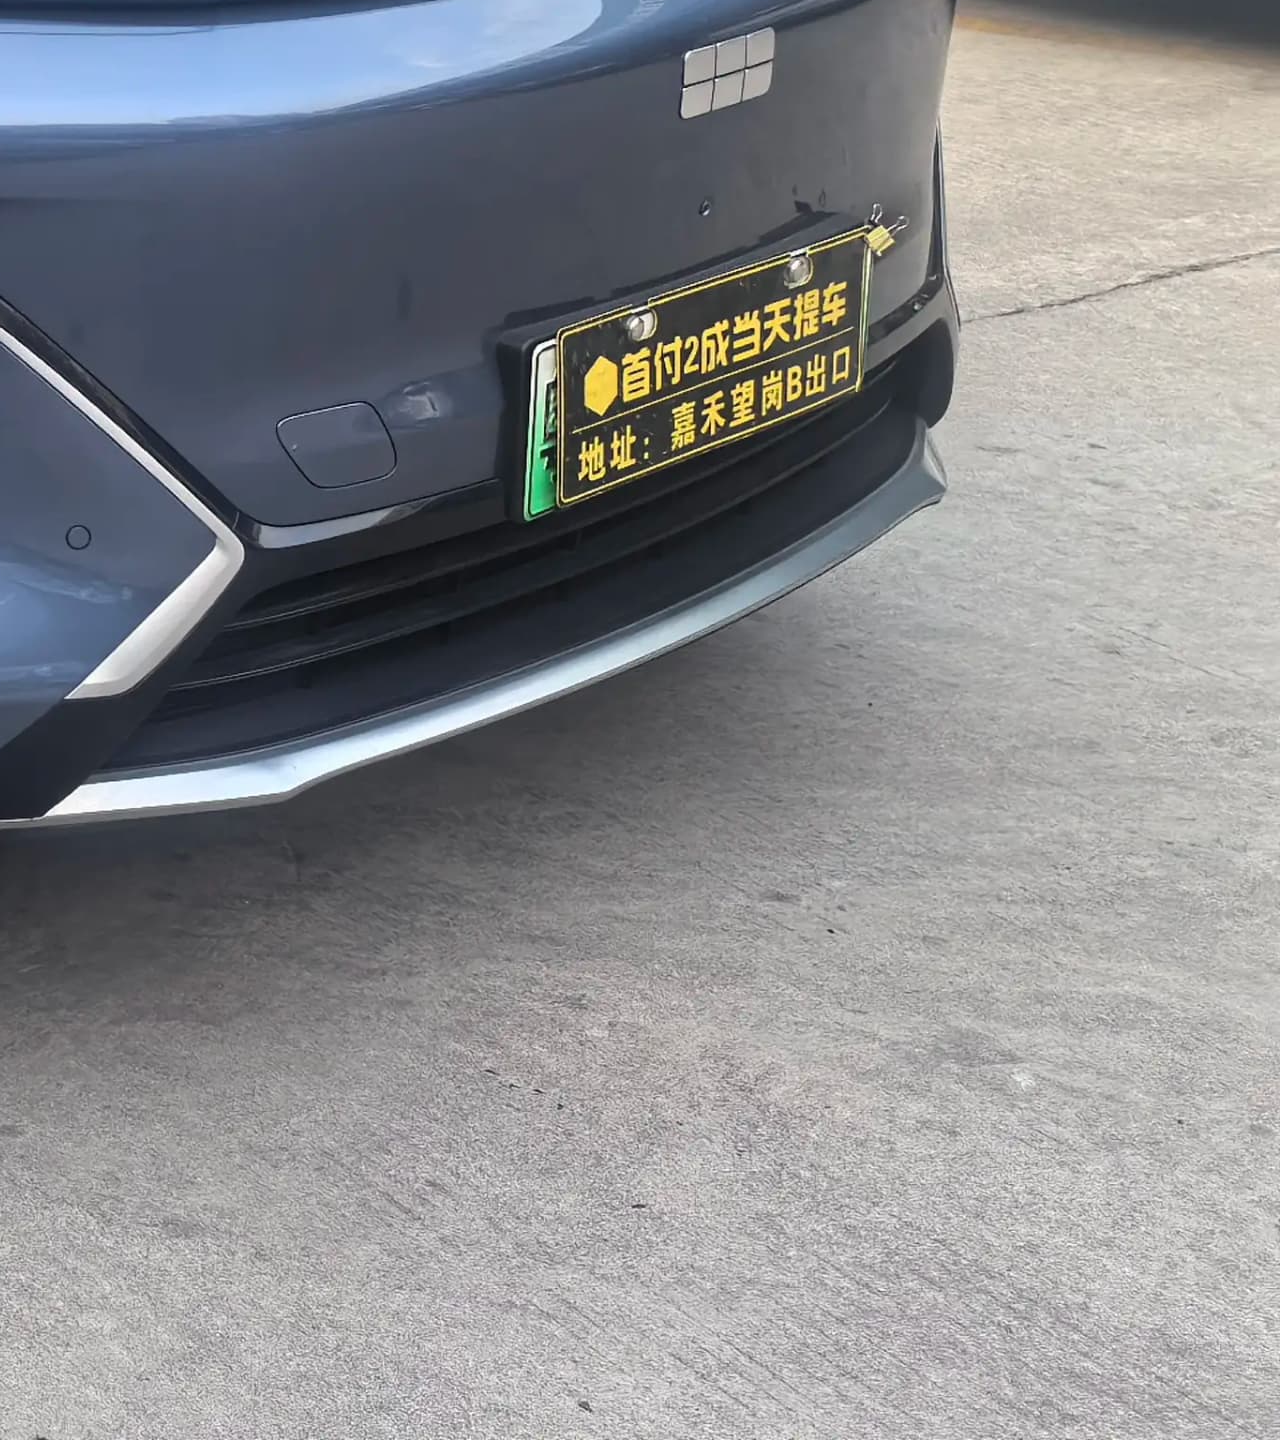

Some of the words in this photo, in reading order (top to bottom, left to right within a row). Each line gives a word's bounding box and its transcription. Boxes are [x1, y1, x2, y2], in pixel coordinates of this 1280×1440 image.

[621, 281, 848, 403] 首付2成当天提车
